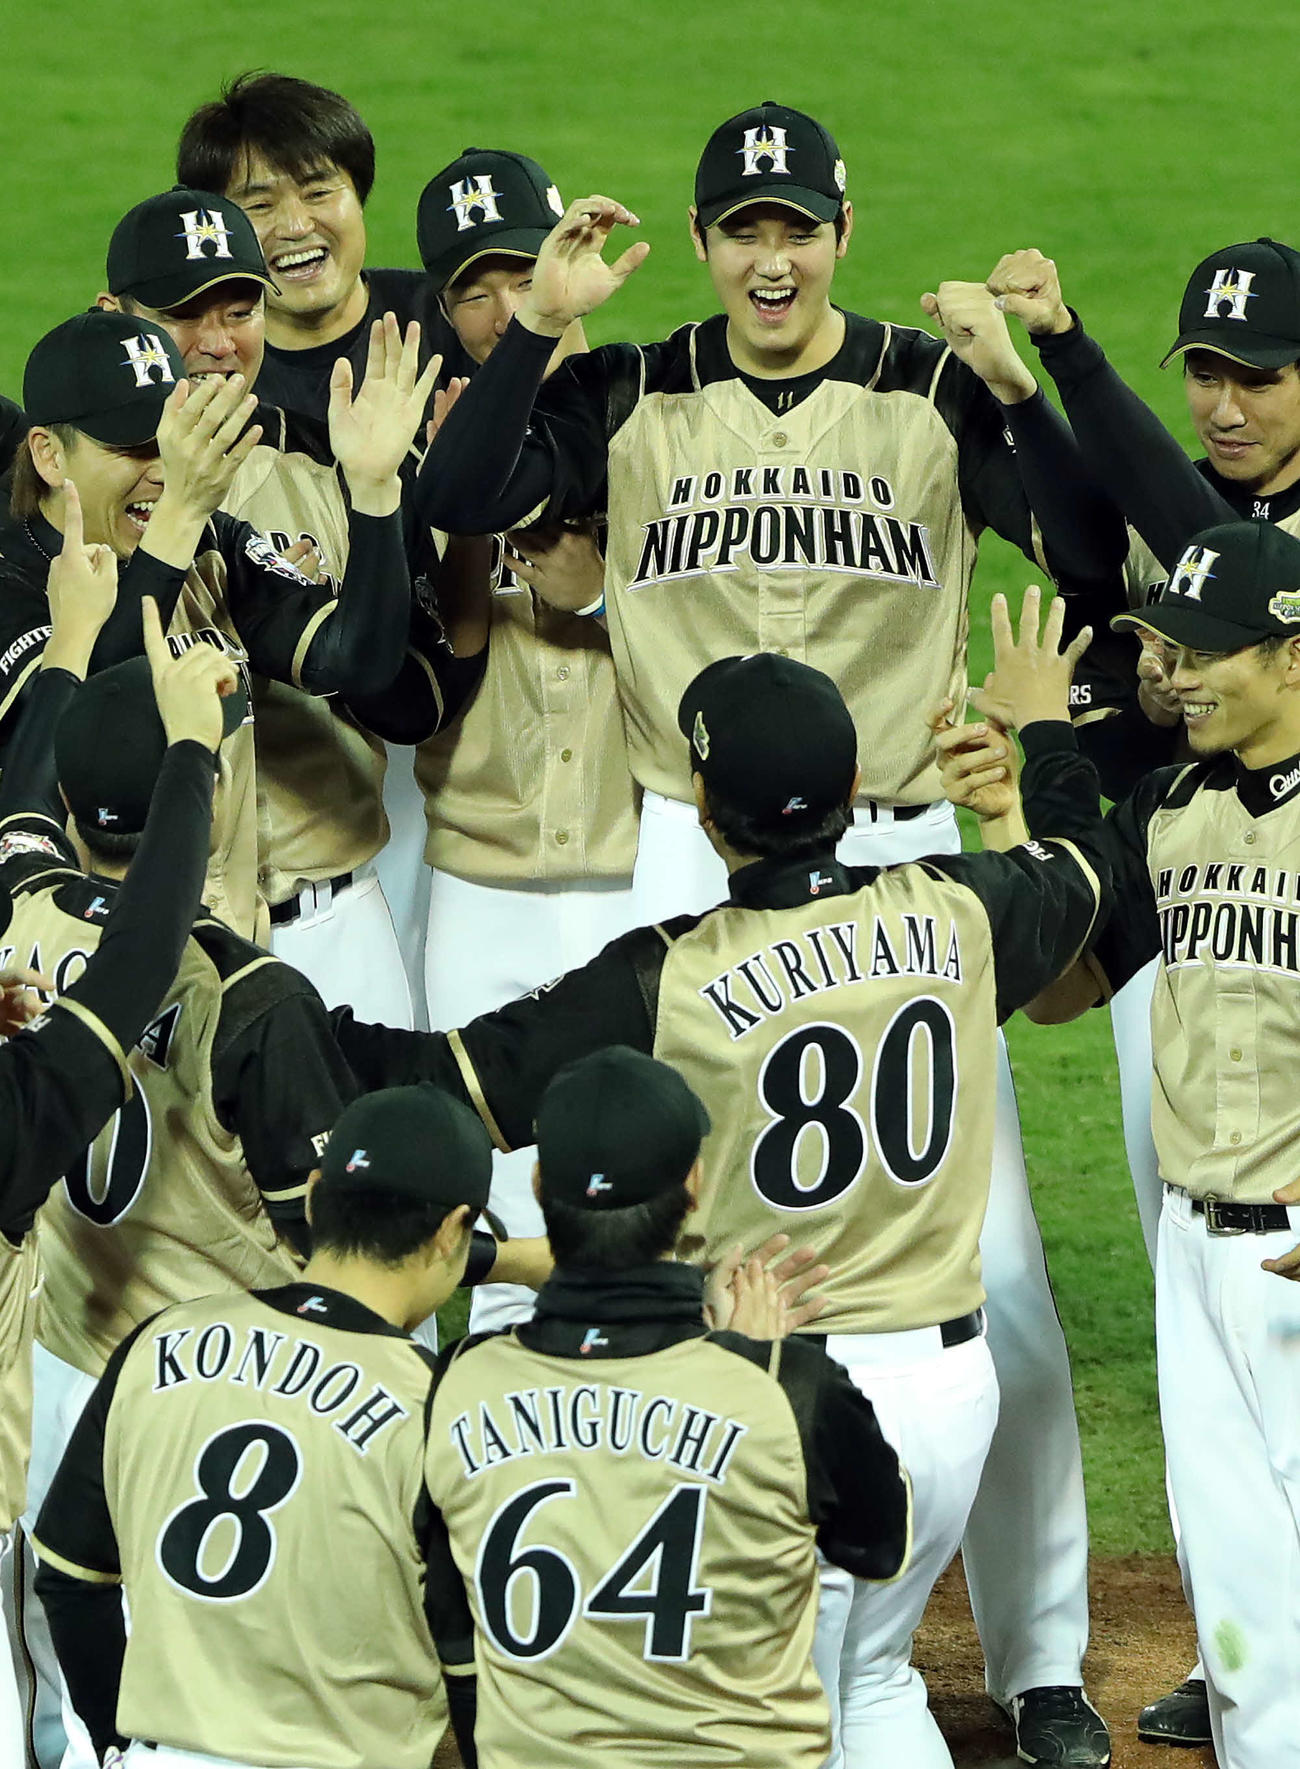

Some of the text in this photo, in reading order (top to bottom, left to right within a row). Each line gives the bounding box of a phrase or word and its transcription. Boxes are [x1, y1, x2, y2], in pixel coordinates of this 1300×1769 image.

[740, 126, 792, 176] H
[448, 174, 503, 232] H
[176, 207, 232, 260] H
[1203, 267, 1257, 321] H
[120, 333, 175, 388] H
[666, 465, 896, 512] HOKKAIDO
[1251, 500, 1271, 520] 34
[626, 504, 942, 592] NIPPONHAM
[1168, 544, 1222, 602] H
[1156, 862, 1300, 906] HOKKAI
[1157, 900, 1300, 980] IPPONH
[700, 912, 963, 1042] KURIYAMA
[750, 994, 959, 1213] 80
[151, 1322, 406, 1456] KONDOH
[450, 1383, 748, 1485] TANIGUCHI
[154, 1420, 303, 1603] 8
[473, 1477, 713, 1663] 64
